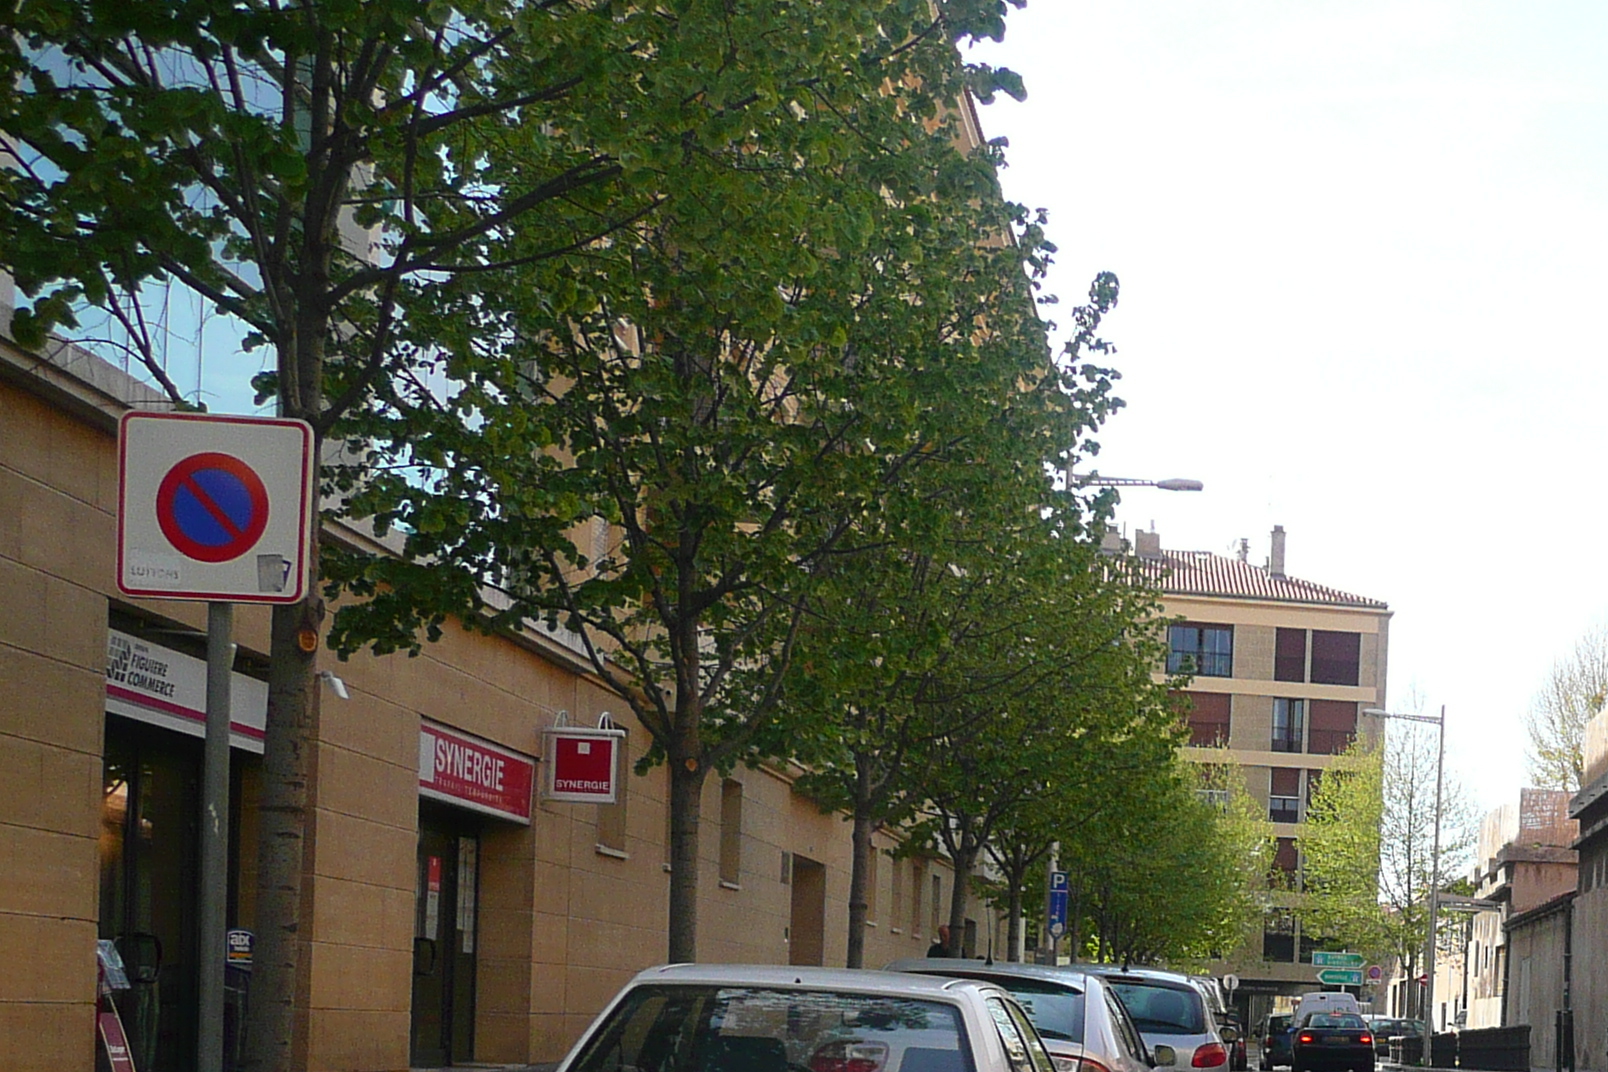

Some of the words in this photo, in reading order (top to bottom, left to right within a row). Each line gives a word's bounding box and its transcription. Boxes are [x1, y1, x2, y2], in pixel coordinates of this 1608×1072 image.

[130, 653, 168, 677] FIGUIERE
[127, 671, 176, 698] COMMERCE
[435, 738, 505, 792] SYNERGIE
[556, 778, 609, 791] SYNERGIE
[1053, 874, 1065, 889] P
